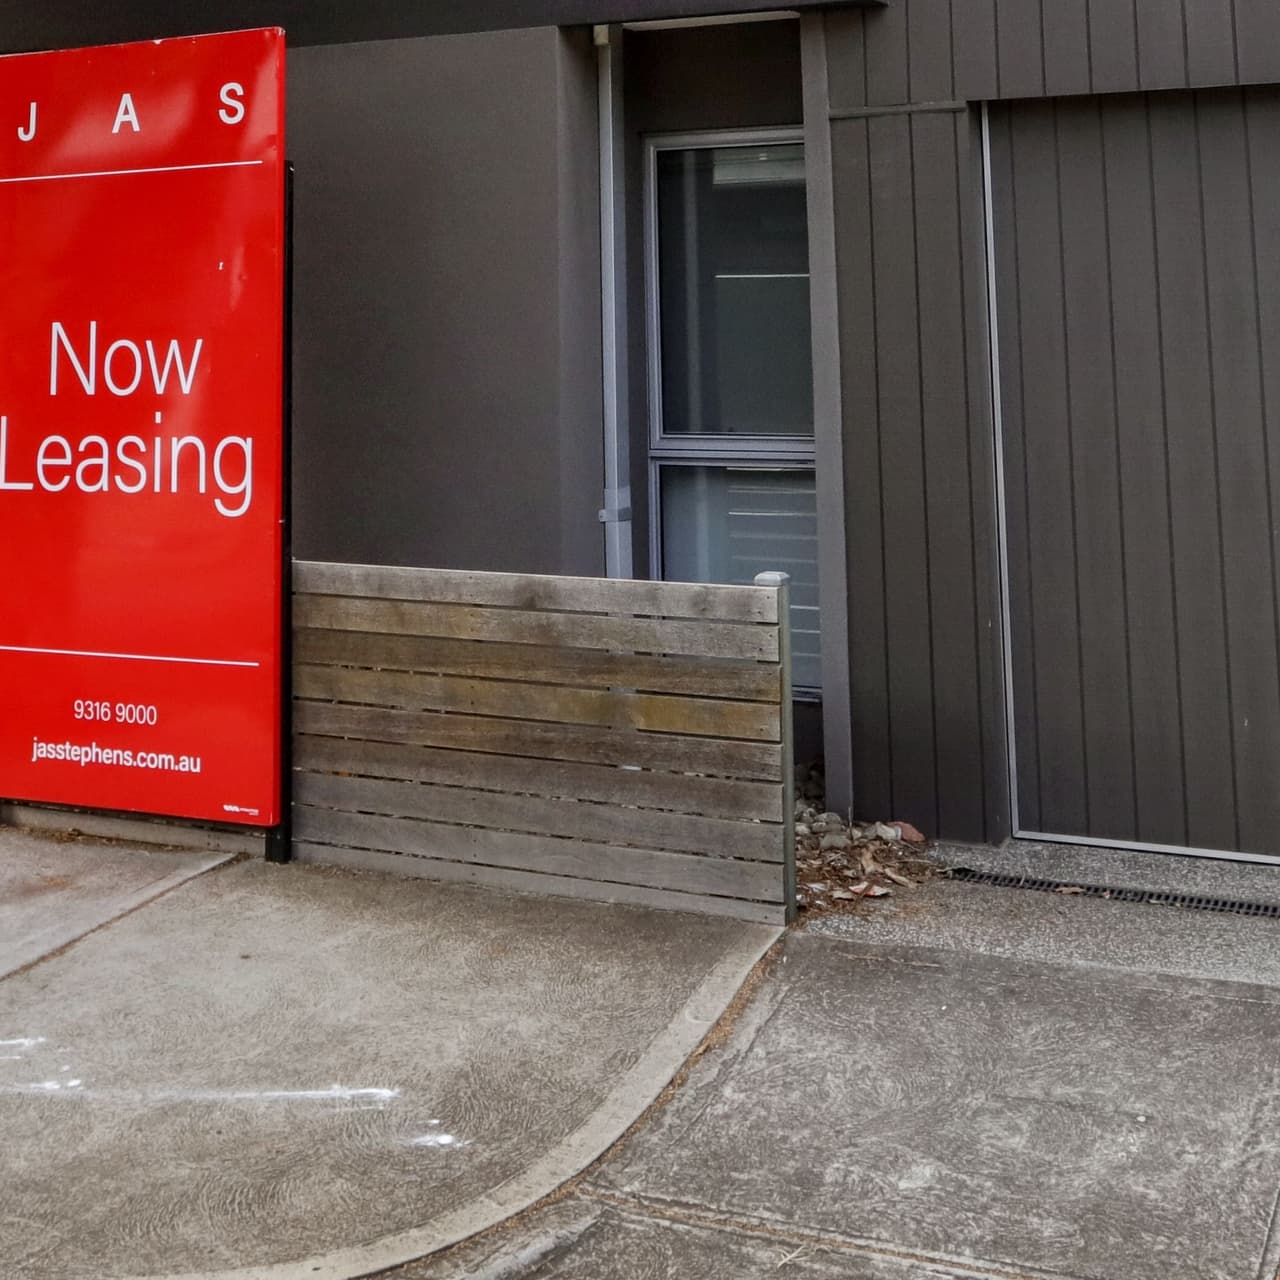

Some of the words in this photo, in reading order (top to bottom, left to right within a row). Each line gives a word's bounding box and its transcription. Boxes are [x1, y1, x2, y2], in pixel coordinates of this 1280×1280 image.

[50, 320, 203, 396] Now
[74, 699, 111, 721] 9316
[115, 703, 157, 726] 9000
[32, 736, 201, 773] jasstephens.com.au
